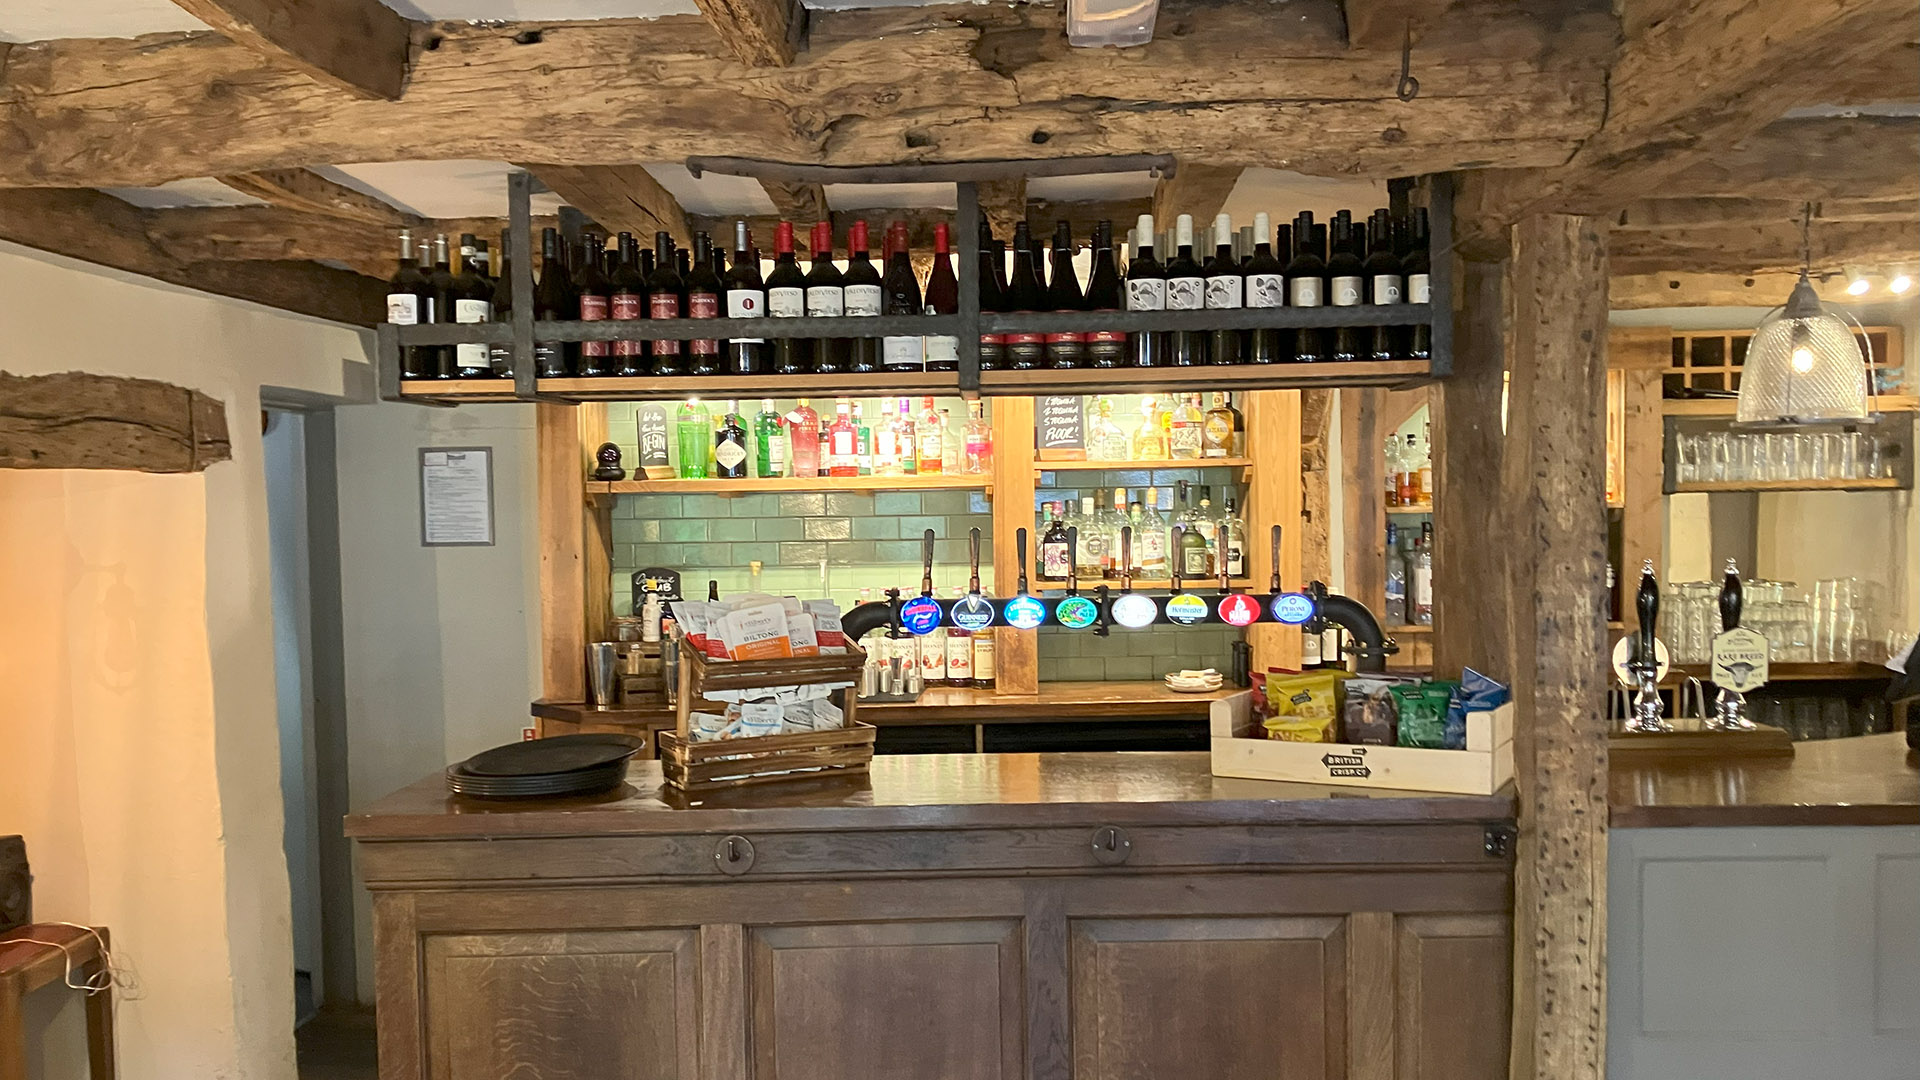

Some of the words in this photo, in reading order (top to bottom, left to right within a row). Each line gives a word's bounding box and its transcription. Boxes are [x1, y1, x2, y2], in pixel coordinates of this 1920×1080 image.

[1045, 427, 1079, 441] FLOOR!
[1172, 606, 1203, 614] Hofmeister
[957, 613, 990, 621] GUINNESS
[743, 630, 780, 643] BILTONG
[745, 638, 781, 650] ORIGINAL
[1717, 653, 1736, 661] RARE
[1739, 653, 1764, 661] BREED
[1328, 756, 1362, 765] BRITISH
